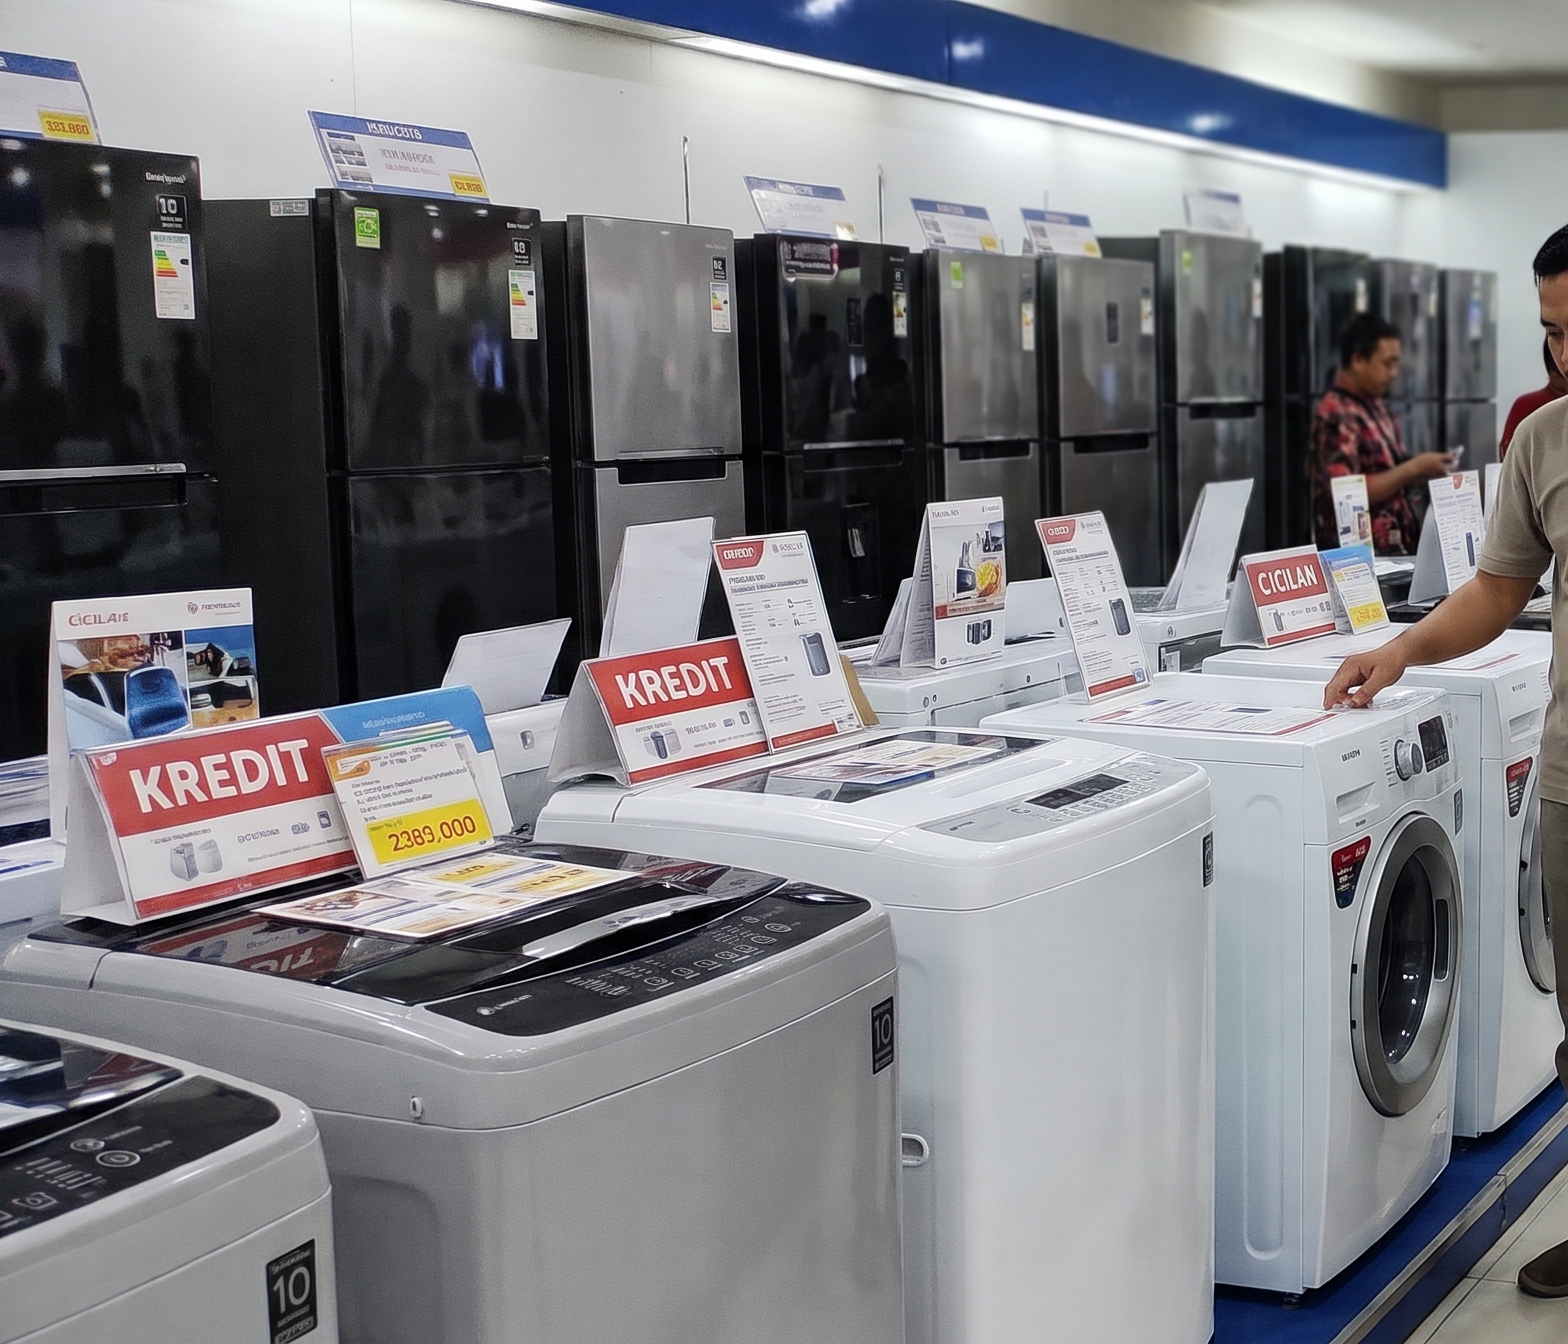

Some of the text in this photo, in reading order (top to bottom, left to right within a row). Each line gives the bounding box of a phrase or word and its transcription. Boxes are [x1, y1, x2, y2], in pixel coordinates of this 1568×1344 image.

[158, 198, 178, 214] 10
[1257, 564, 1318, 596] CICILAN
[615, 656, 733, 709] KREDIT
[129, 738, 309, 814] KREDIT
[874, 1013, 892, 1050] 10
[272, 1266, 311, 1314] 10
